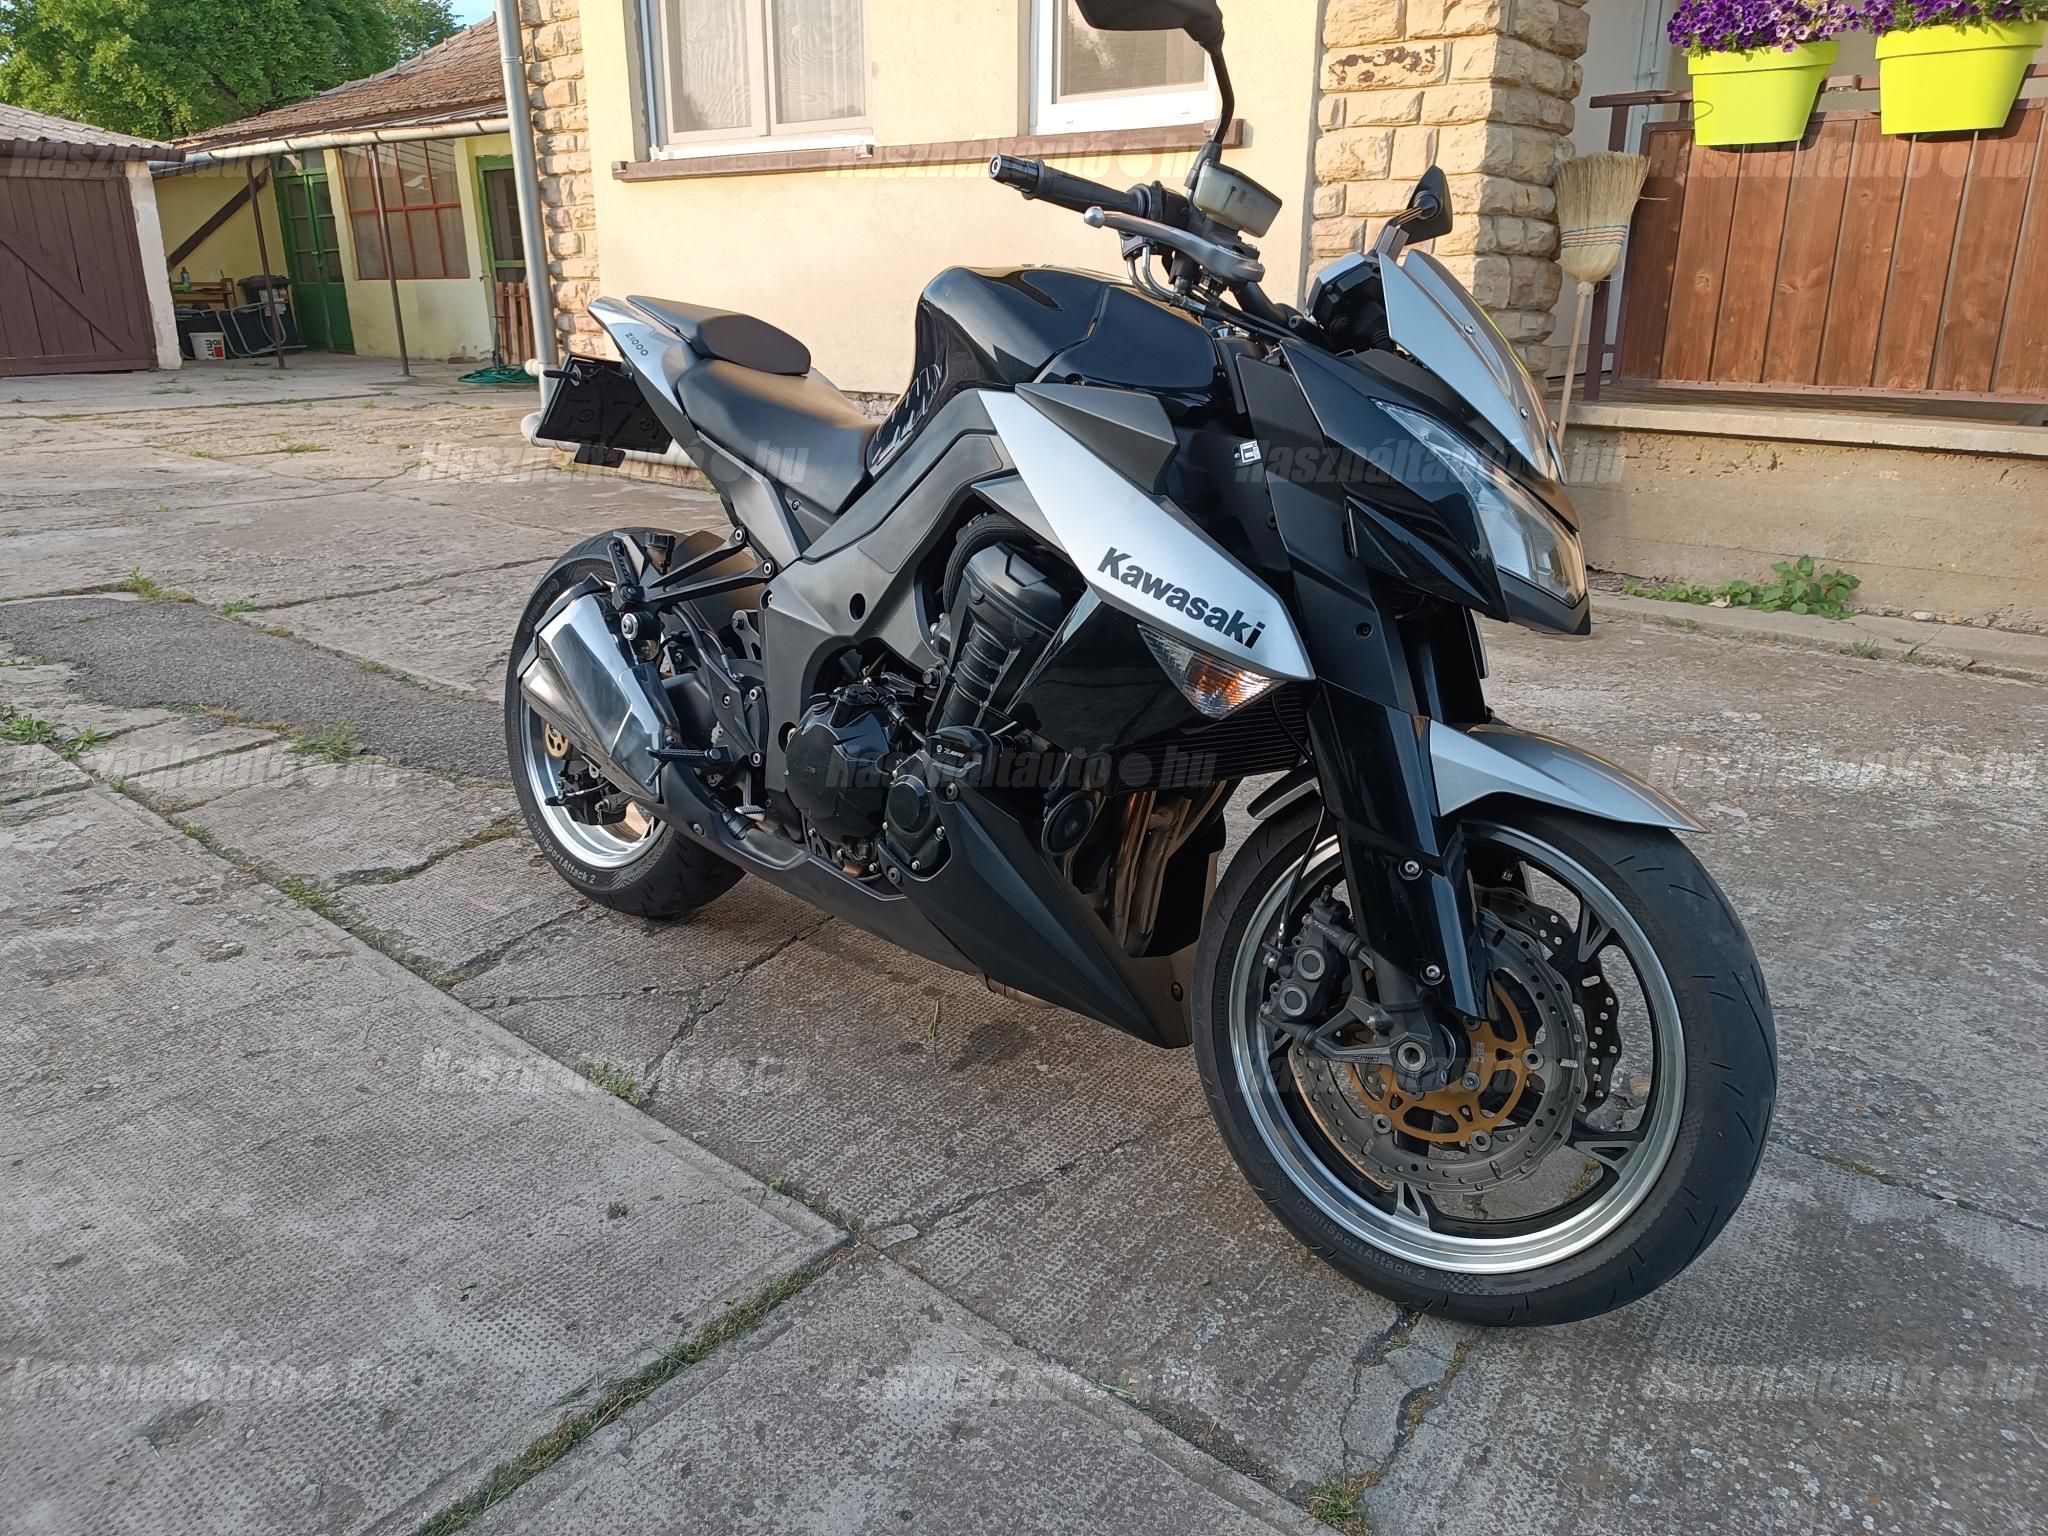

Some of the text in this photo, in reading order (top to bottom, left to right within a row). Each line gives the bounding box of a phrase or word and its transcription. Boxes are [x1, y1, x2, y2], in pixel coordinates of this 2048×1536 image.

[1097, 546, 1266, 649] Kawasaki
[1475, 1041, 1485, 1064] EBC
[1296, 1199, 1427, 1281] ContiSportAttack 2
